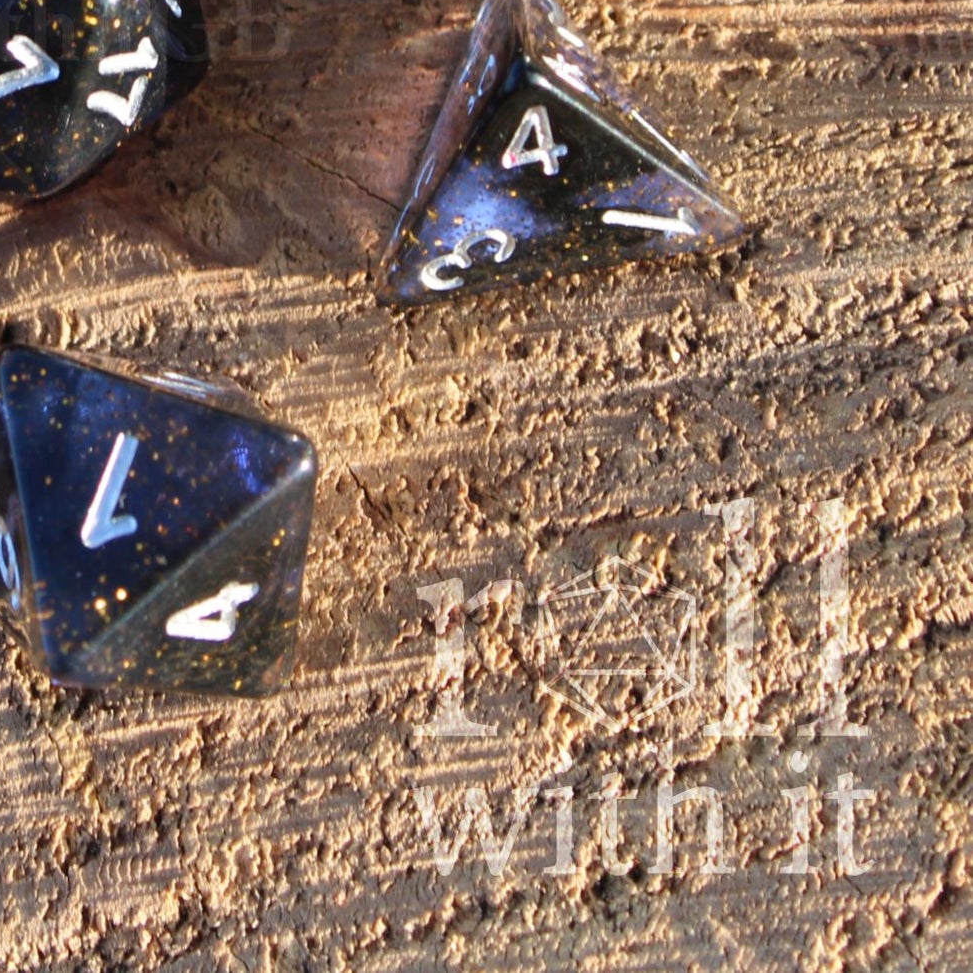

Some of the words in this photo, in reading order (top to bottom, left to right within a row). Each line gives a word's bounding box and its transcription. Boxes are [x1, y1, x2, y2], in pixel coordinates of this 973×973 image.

[86, 35, 159, 127] 17
[501, 104, 568, 177] 4
[420, 228, 516, 292] 3
[165, 581, 260, 642] 4
